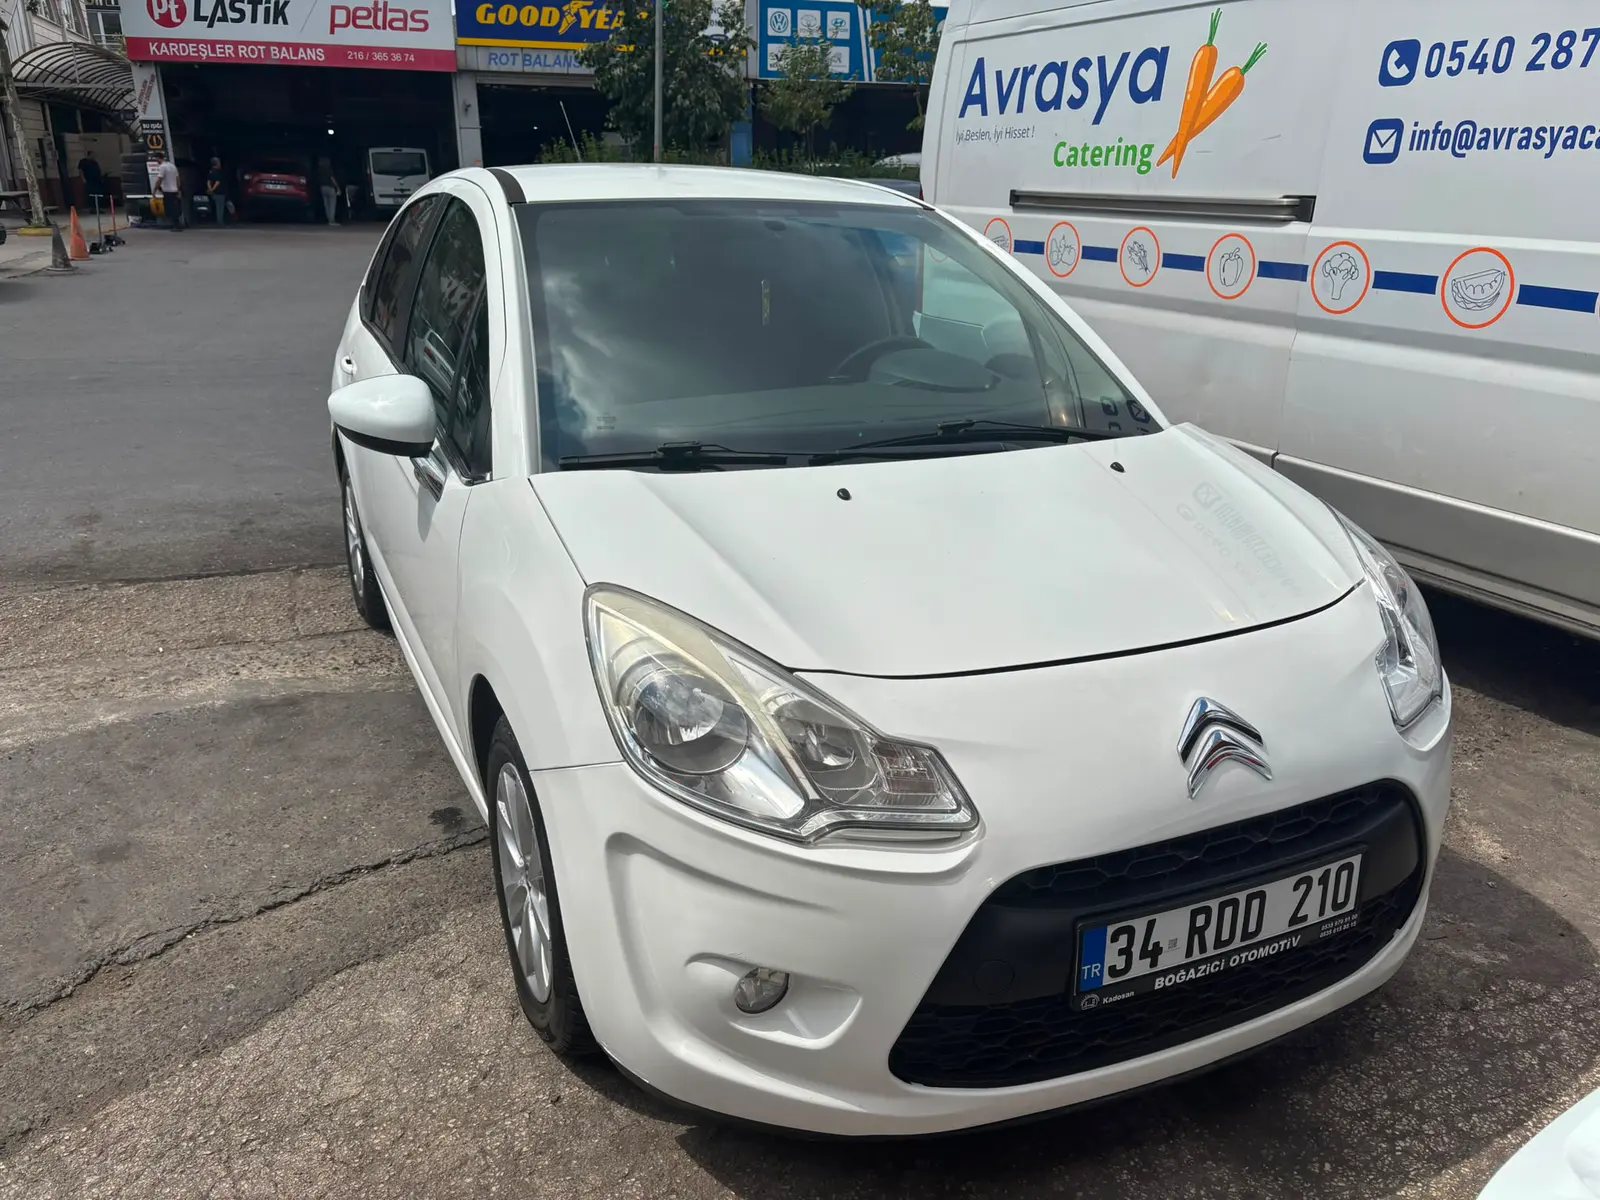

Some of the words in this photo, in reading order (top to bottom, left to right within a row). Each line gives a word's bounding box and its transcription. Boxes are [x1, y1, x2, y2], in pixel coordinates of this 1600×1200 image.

[329, 0, 429, 35] petlas
[476, 3, 649, 30] GOODYEA
[149, 42, 234, 60] KARDEŞLER
[238, 45, 266, 59] ROT
[270, 46, 325, 62] BALANS
[347, 51, 364, 60] 216
[488, 52, 520, 66] ROT
[1424, 35, 1516, 78] 0540
[1525, 27, 1600, 72] 287
[958, 45, 1170, 125] Avrasya
[965, 126, 992, 142] Beslen,
[1005, 126, 1031, 140] Hisset
[1053, 137, 1155, 175] Catering
[1107, 918, 1164, 979] 34
[1184, 889, 1267, 959] RDD
[1287, 861, 1355, 928] 210
[1082, 963, 1102, 980] TR
[1102, 990, 1135, 1004] Kadosan
